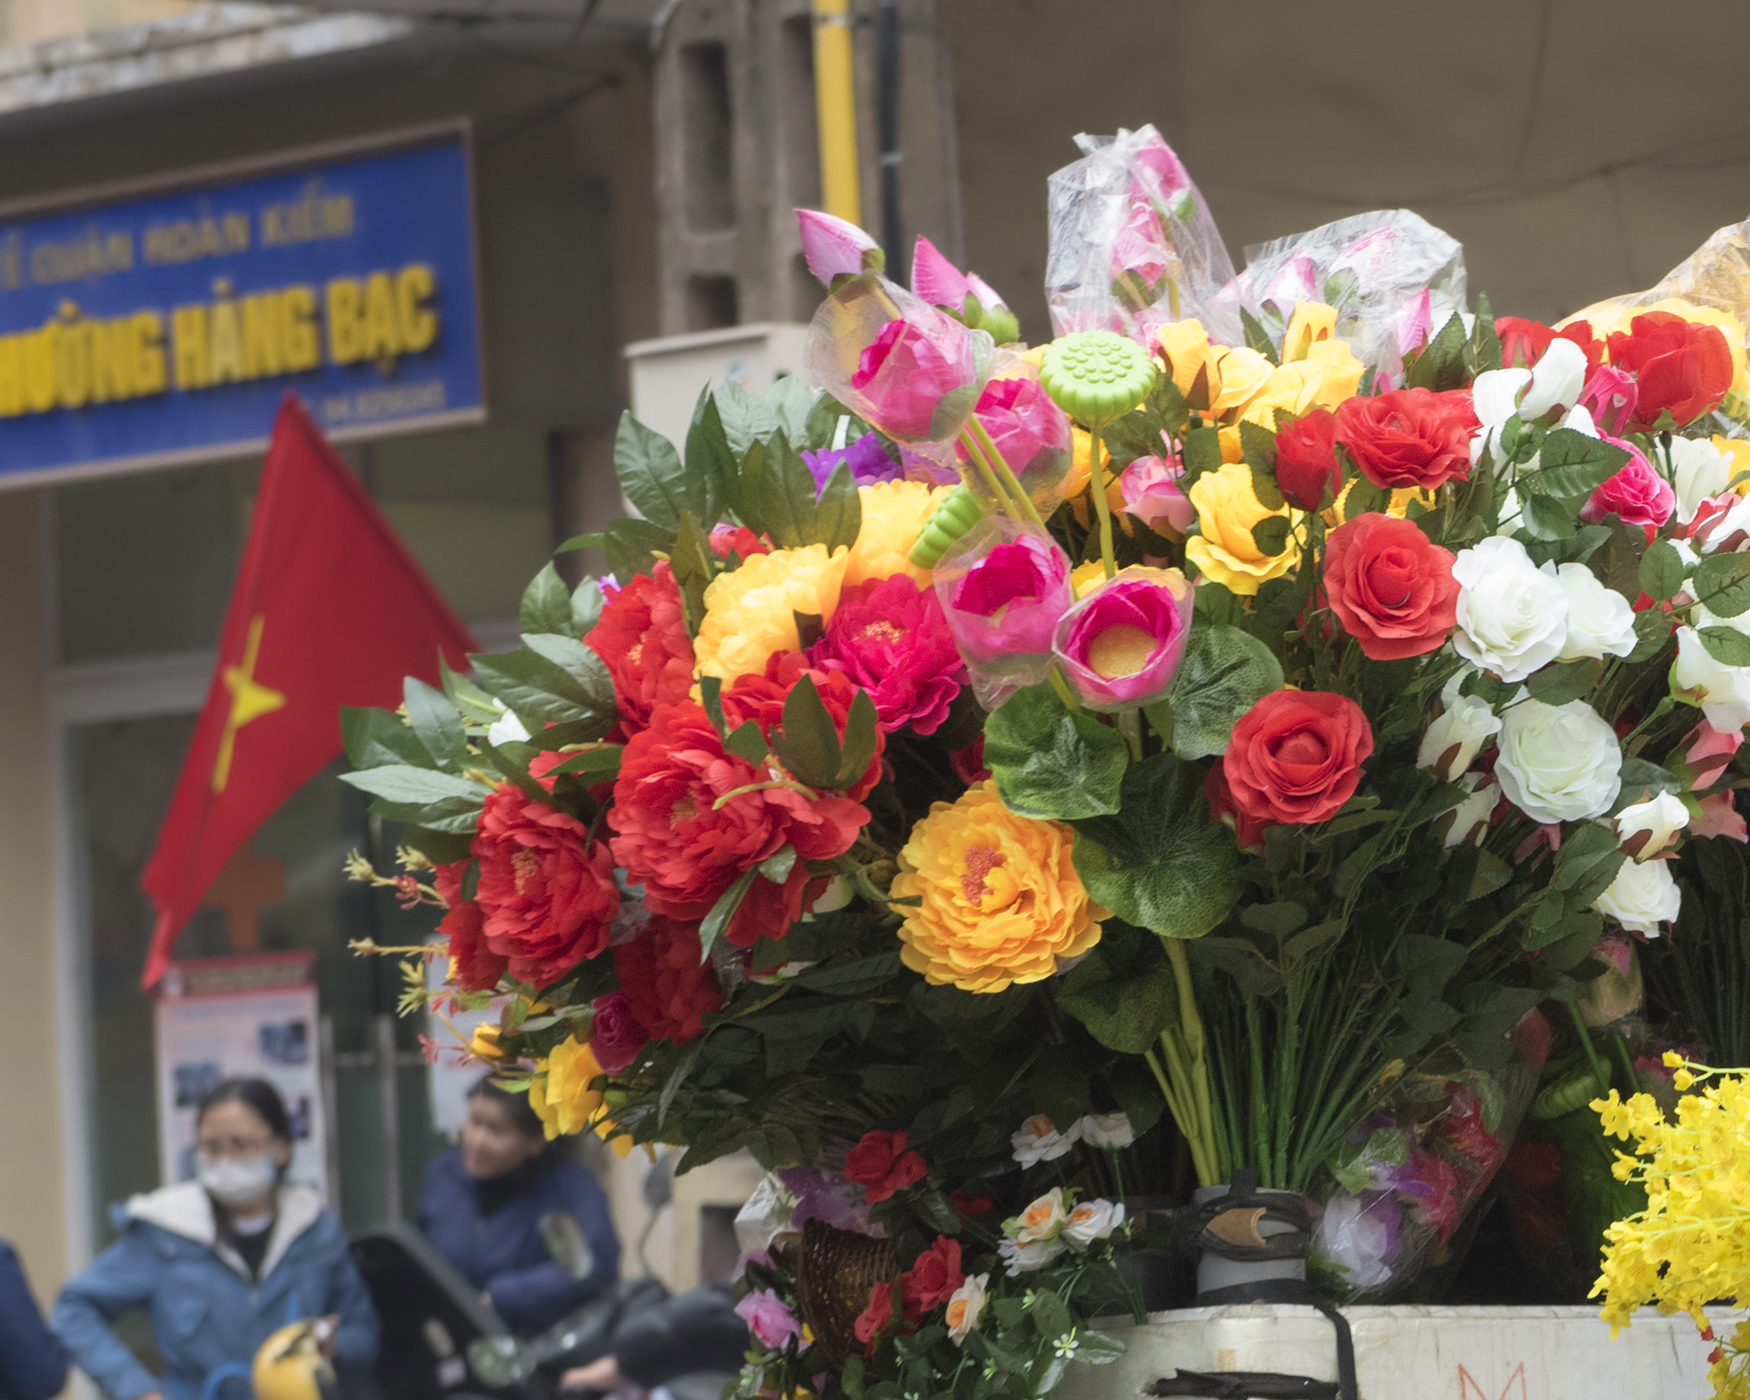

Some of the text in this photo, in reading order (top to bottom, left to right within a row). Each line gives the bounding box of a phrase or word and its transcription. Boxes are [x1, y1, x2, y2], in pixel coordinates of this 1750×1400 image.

[0, 262, 438, 419] HƯỜNG HÀNG BẠC
